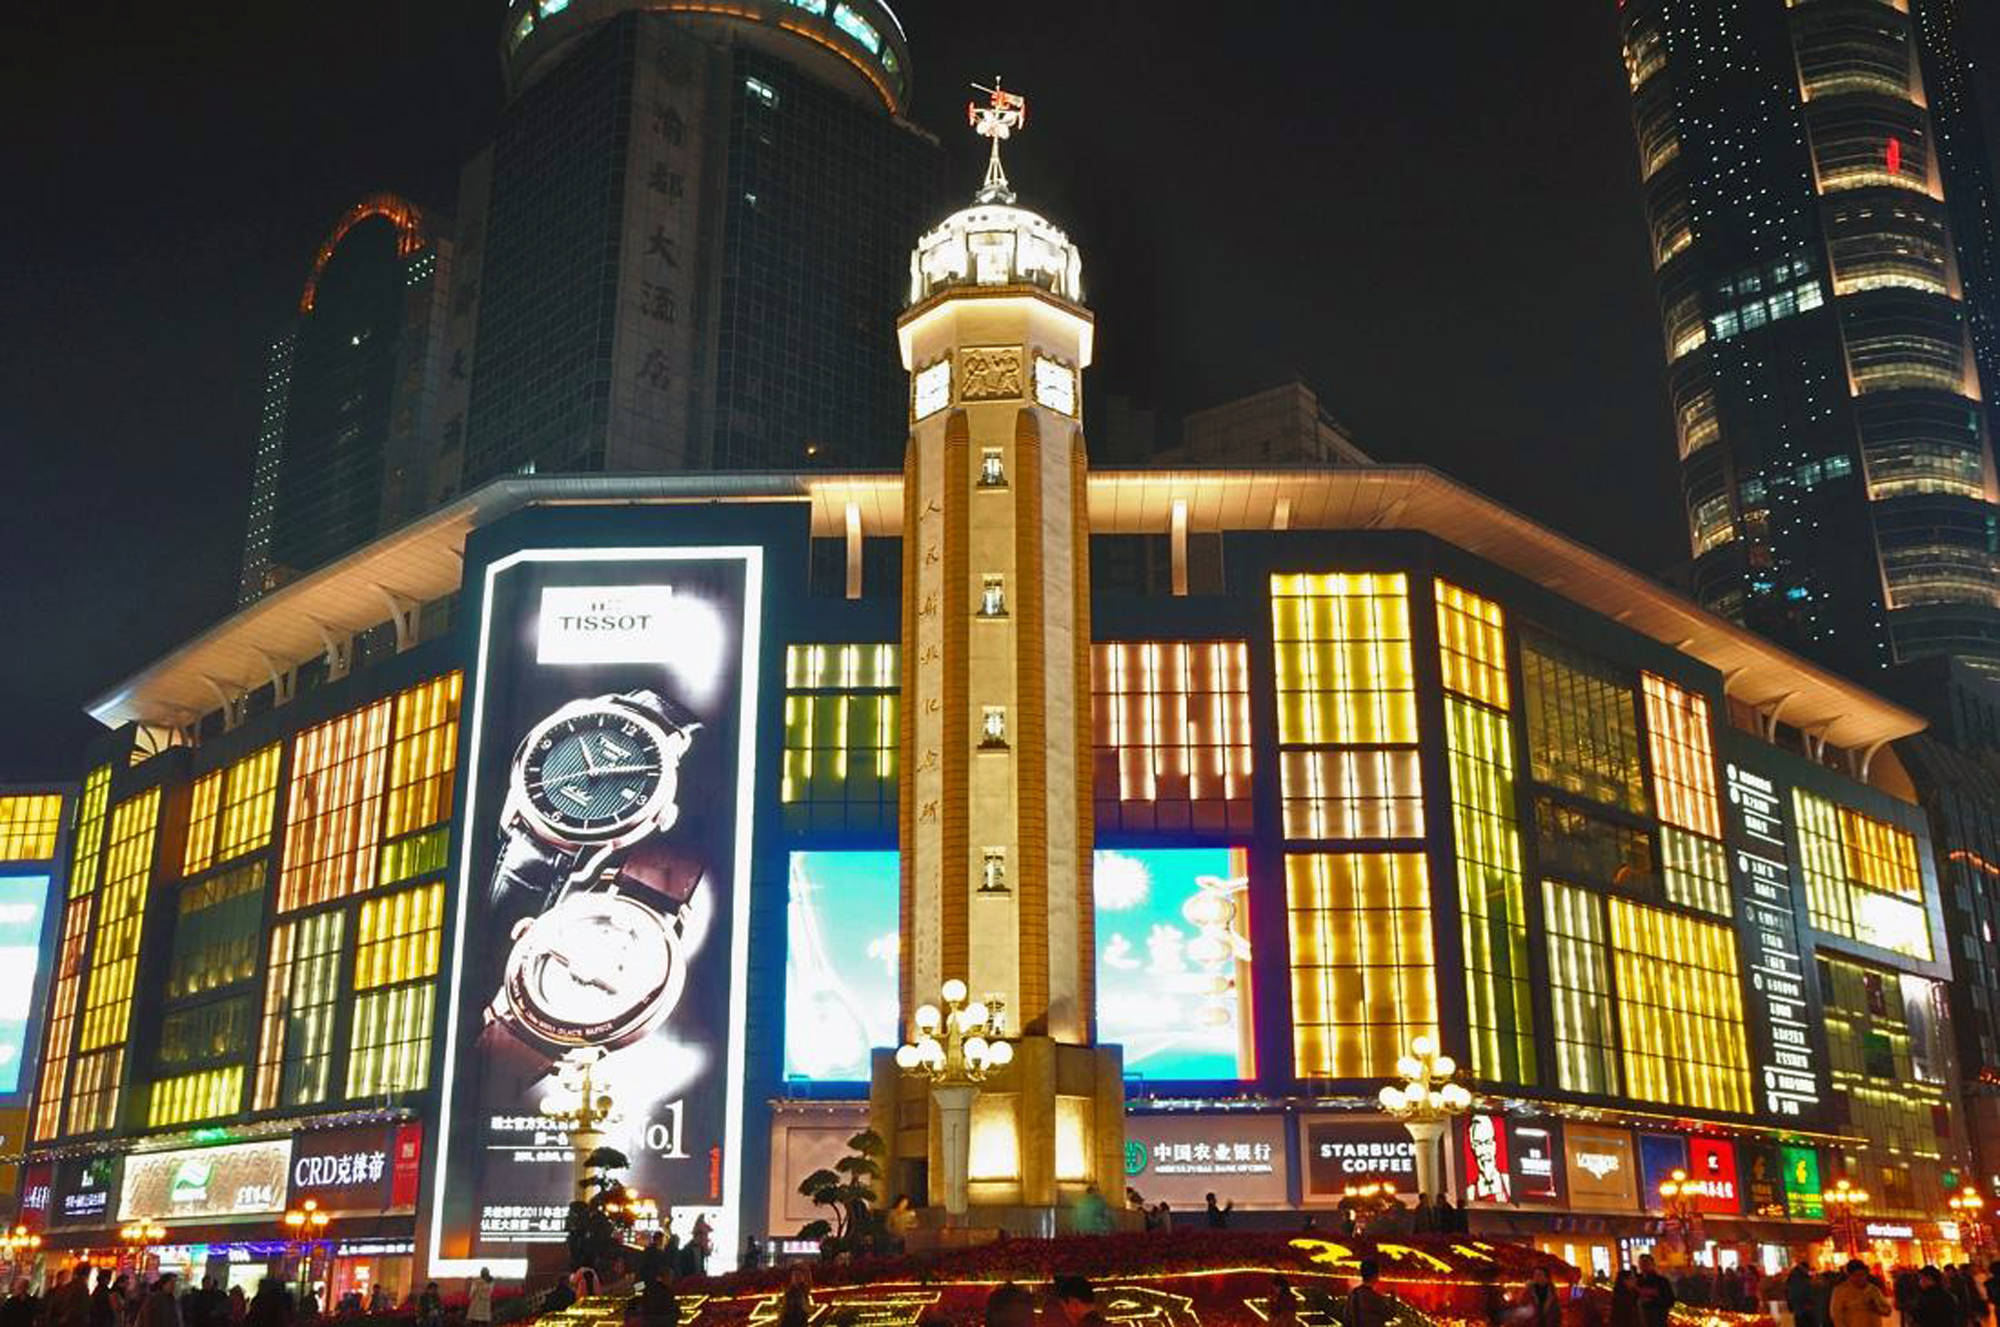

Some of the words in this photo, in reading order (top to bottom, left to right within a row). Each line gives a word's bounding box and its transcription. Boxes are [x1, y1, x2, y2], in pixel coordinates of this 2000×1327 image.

[558, 614, 652, 631] TISSOT
[1153, 1142, 1272, 1162] 中国农业银行
[1342, 1158, 1412, 1173] COFFEE
